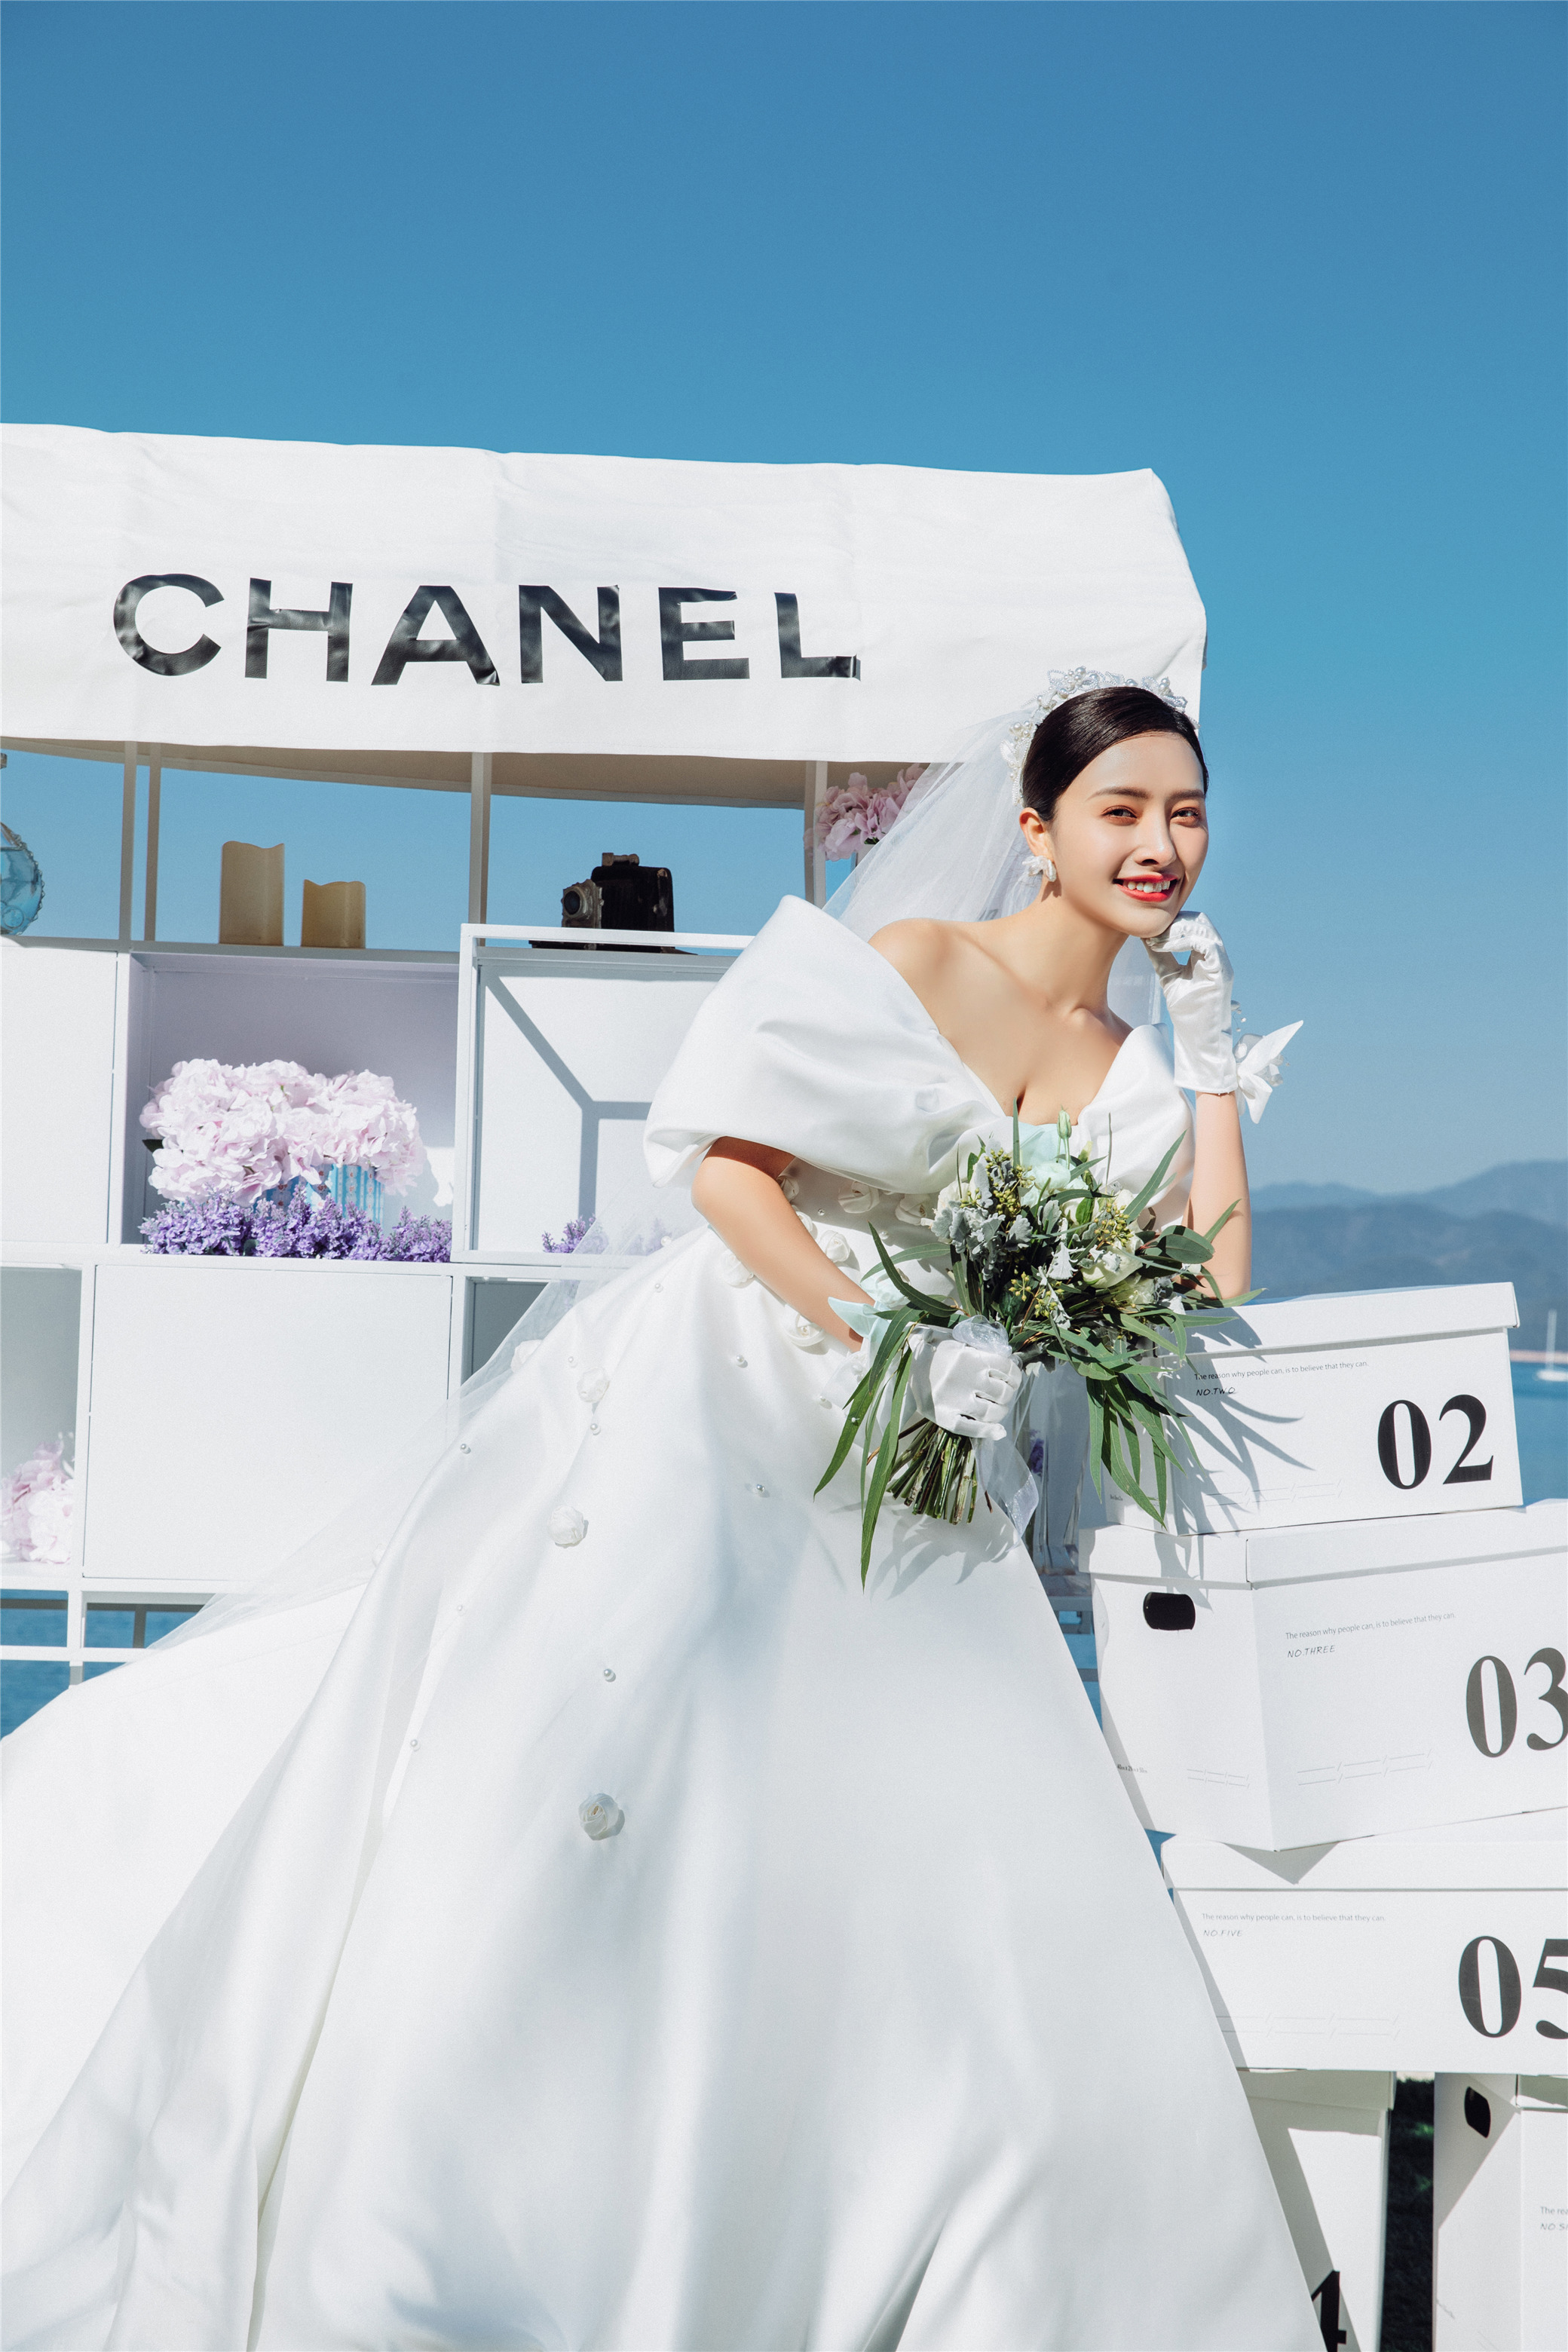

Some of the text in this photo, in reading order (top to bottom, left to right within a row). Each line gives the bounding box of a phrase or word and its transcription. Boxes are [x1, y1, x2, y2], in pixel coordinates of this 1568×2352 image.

[114, 574, 860, 686] CHANEL
[1247, 1368, 1269, 1377] people
[1340, 1361, 1354, 1370] they
[1378, 1395, 1493, 1489] 02
[1300, 1630, 1321, 1638] reason
[1322, 1627, 1336, 1635] why
[1337, 1624, 1360, 1634] people
[1428, 1613, 1442, 1622] they
[1466, 1648, 1568, 1757] 03
[1240, 1913, 1254, 1922] why
[1355, 1914, 1370, 1922] they
[1459, 1936, 1568, 2039] 05
[1540, 2206, 1555, 2215] The
